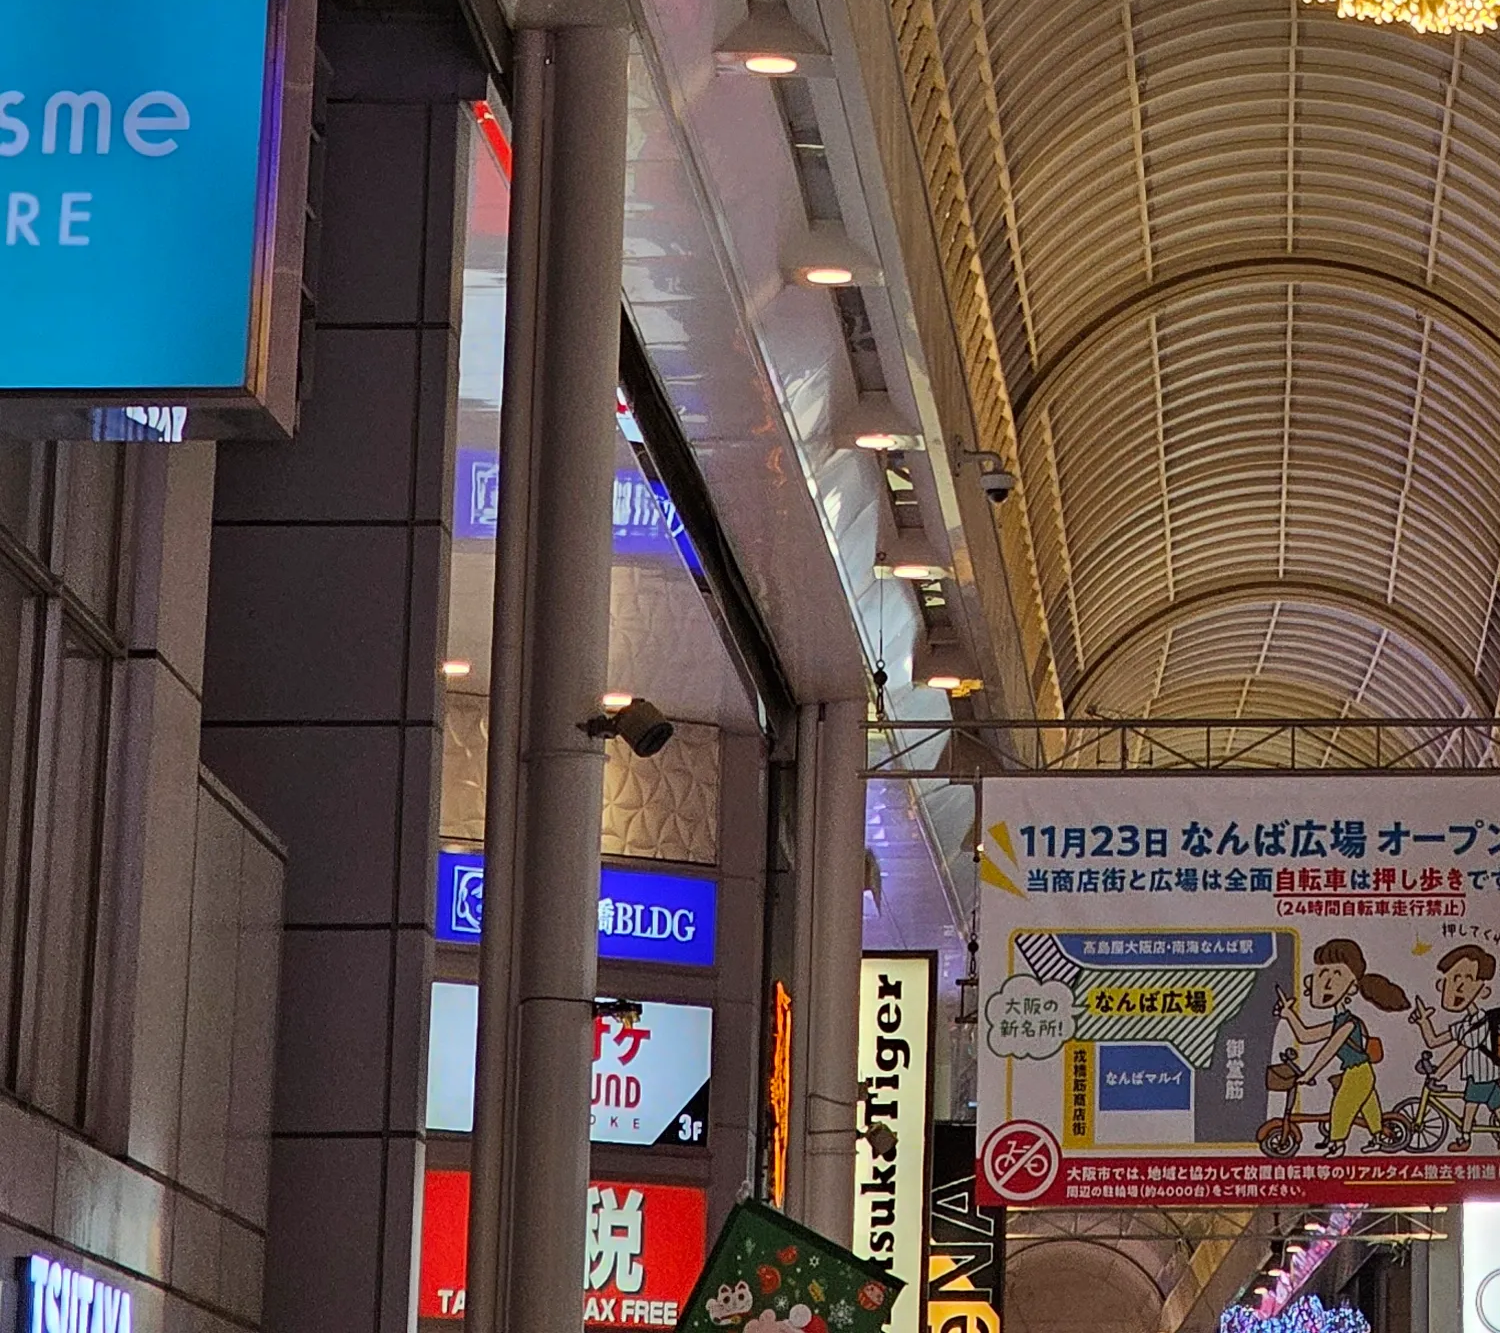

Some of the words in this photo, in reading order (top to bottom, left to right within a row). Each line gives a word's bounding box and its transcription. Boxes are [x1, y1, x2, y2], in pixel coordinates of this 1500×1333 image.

[6, 191, 94, 247] RE
[1019, 824, 1168, 859] 11月23日
[1181, 819, 1368, 859] なんば広場
[1004, 997, 1059, 1015] 大阪の
[1095, 990, 1208, 1015] なんば広場
[864, 973, 911, 1128] Tiger
[1105, 1071, 1184, 1086] なんばマルイ
[1224, 1038, 1245, 1100] 御堂筋
[678, 1113, 703, 1141] 3F
[621, 1298, 679, 1326] FREE
